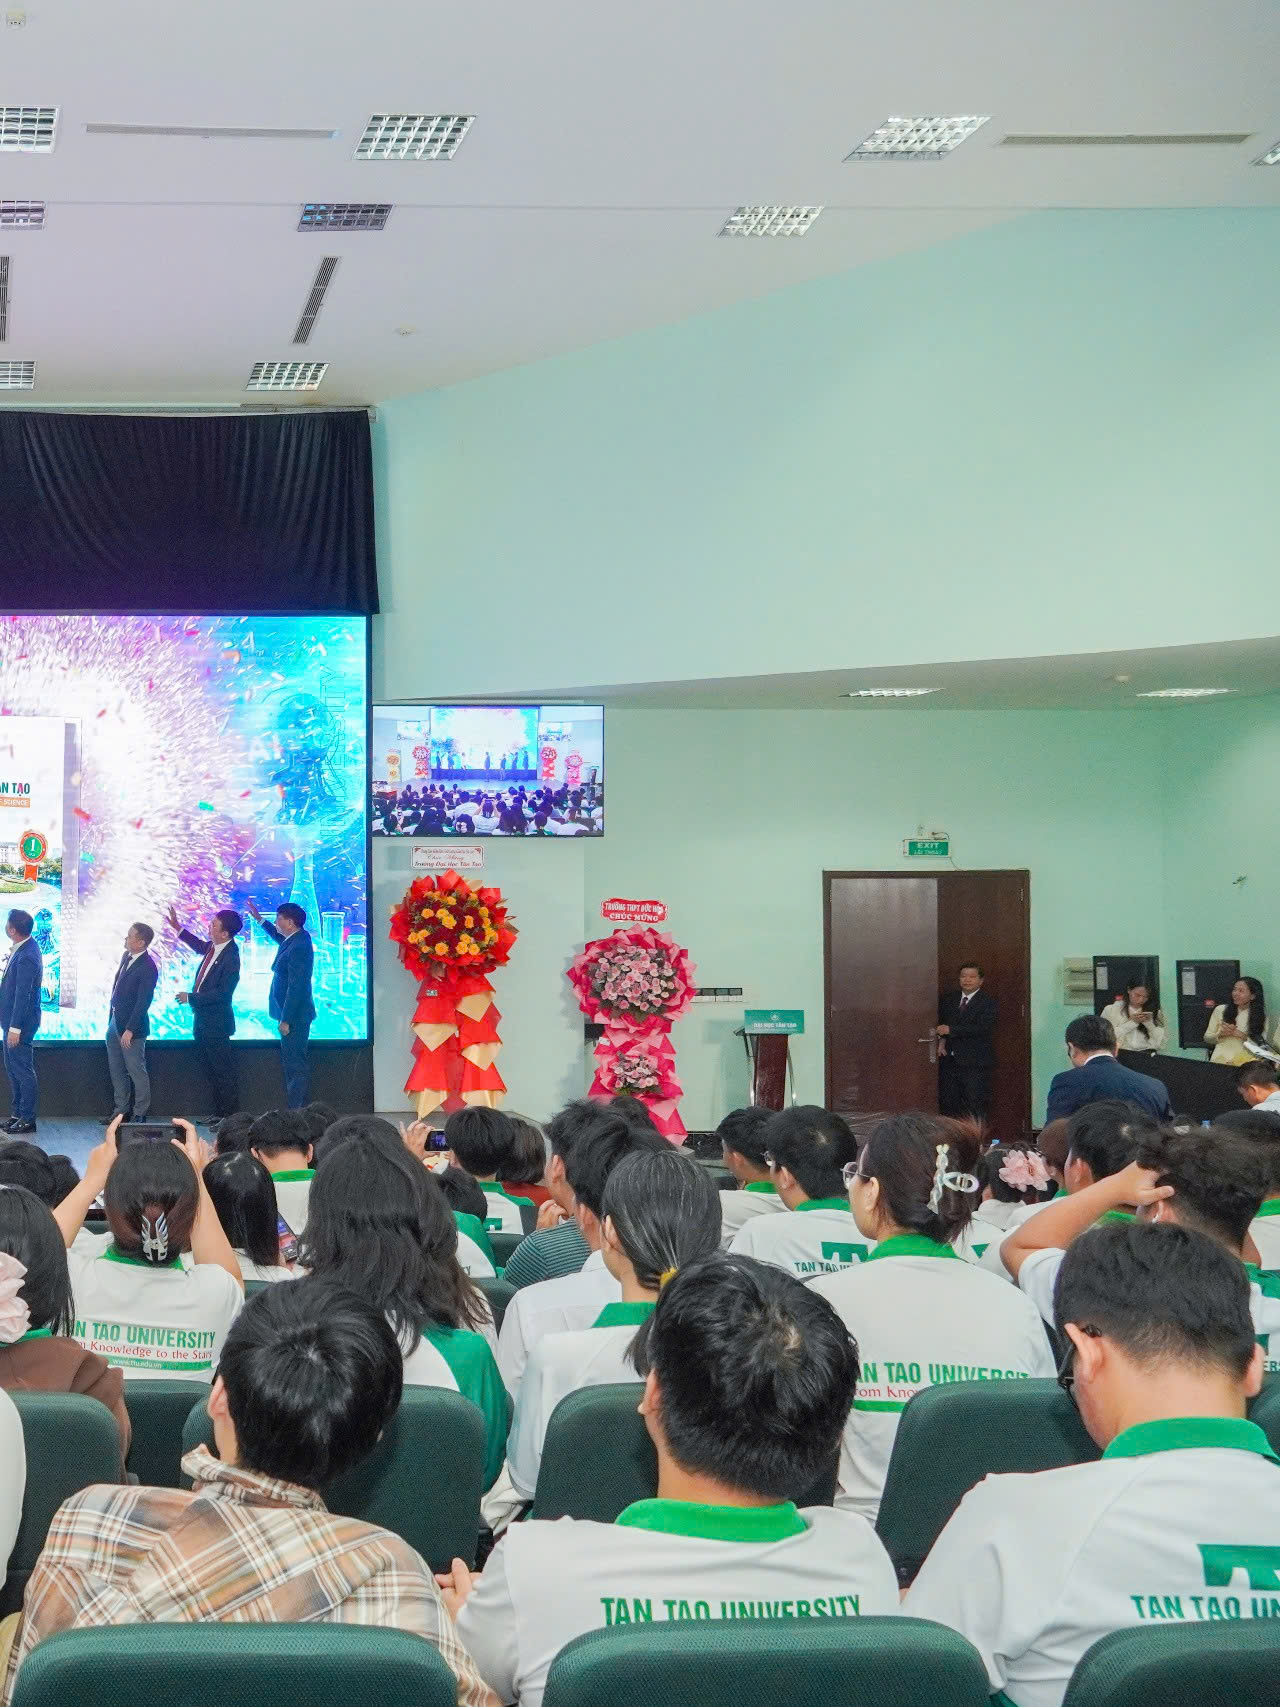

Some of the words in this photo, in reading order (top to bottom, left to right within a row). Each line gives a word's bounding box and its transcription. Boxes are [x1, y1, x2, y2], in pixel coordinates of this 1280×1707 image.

[12, 783, 30, 796] TẠO
[3, 799, 27, 807] SCIENCE
[794, 1262, 816, 1272] TAN
[92, 1322, 121, 1341] TAO
[126, 1325, 216, 1349] UNIVERSITY
[91, 1341, 152, 1358] Knowledge
[156, 1349, 168, 1358] to
[172, 1350, 189, 1359] the
[884, 1362, 921, 1384] TAO
[600, 1597, 653, 1626] TAN
[663, 1600, 711, 1620] TAO
[720, 1595, 860, 1618] UNIVERSITY
[1130, 1595, 1185, 1619] TAN
[1189, 1596, 1241, 1620] TAO
